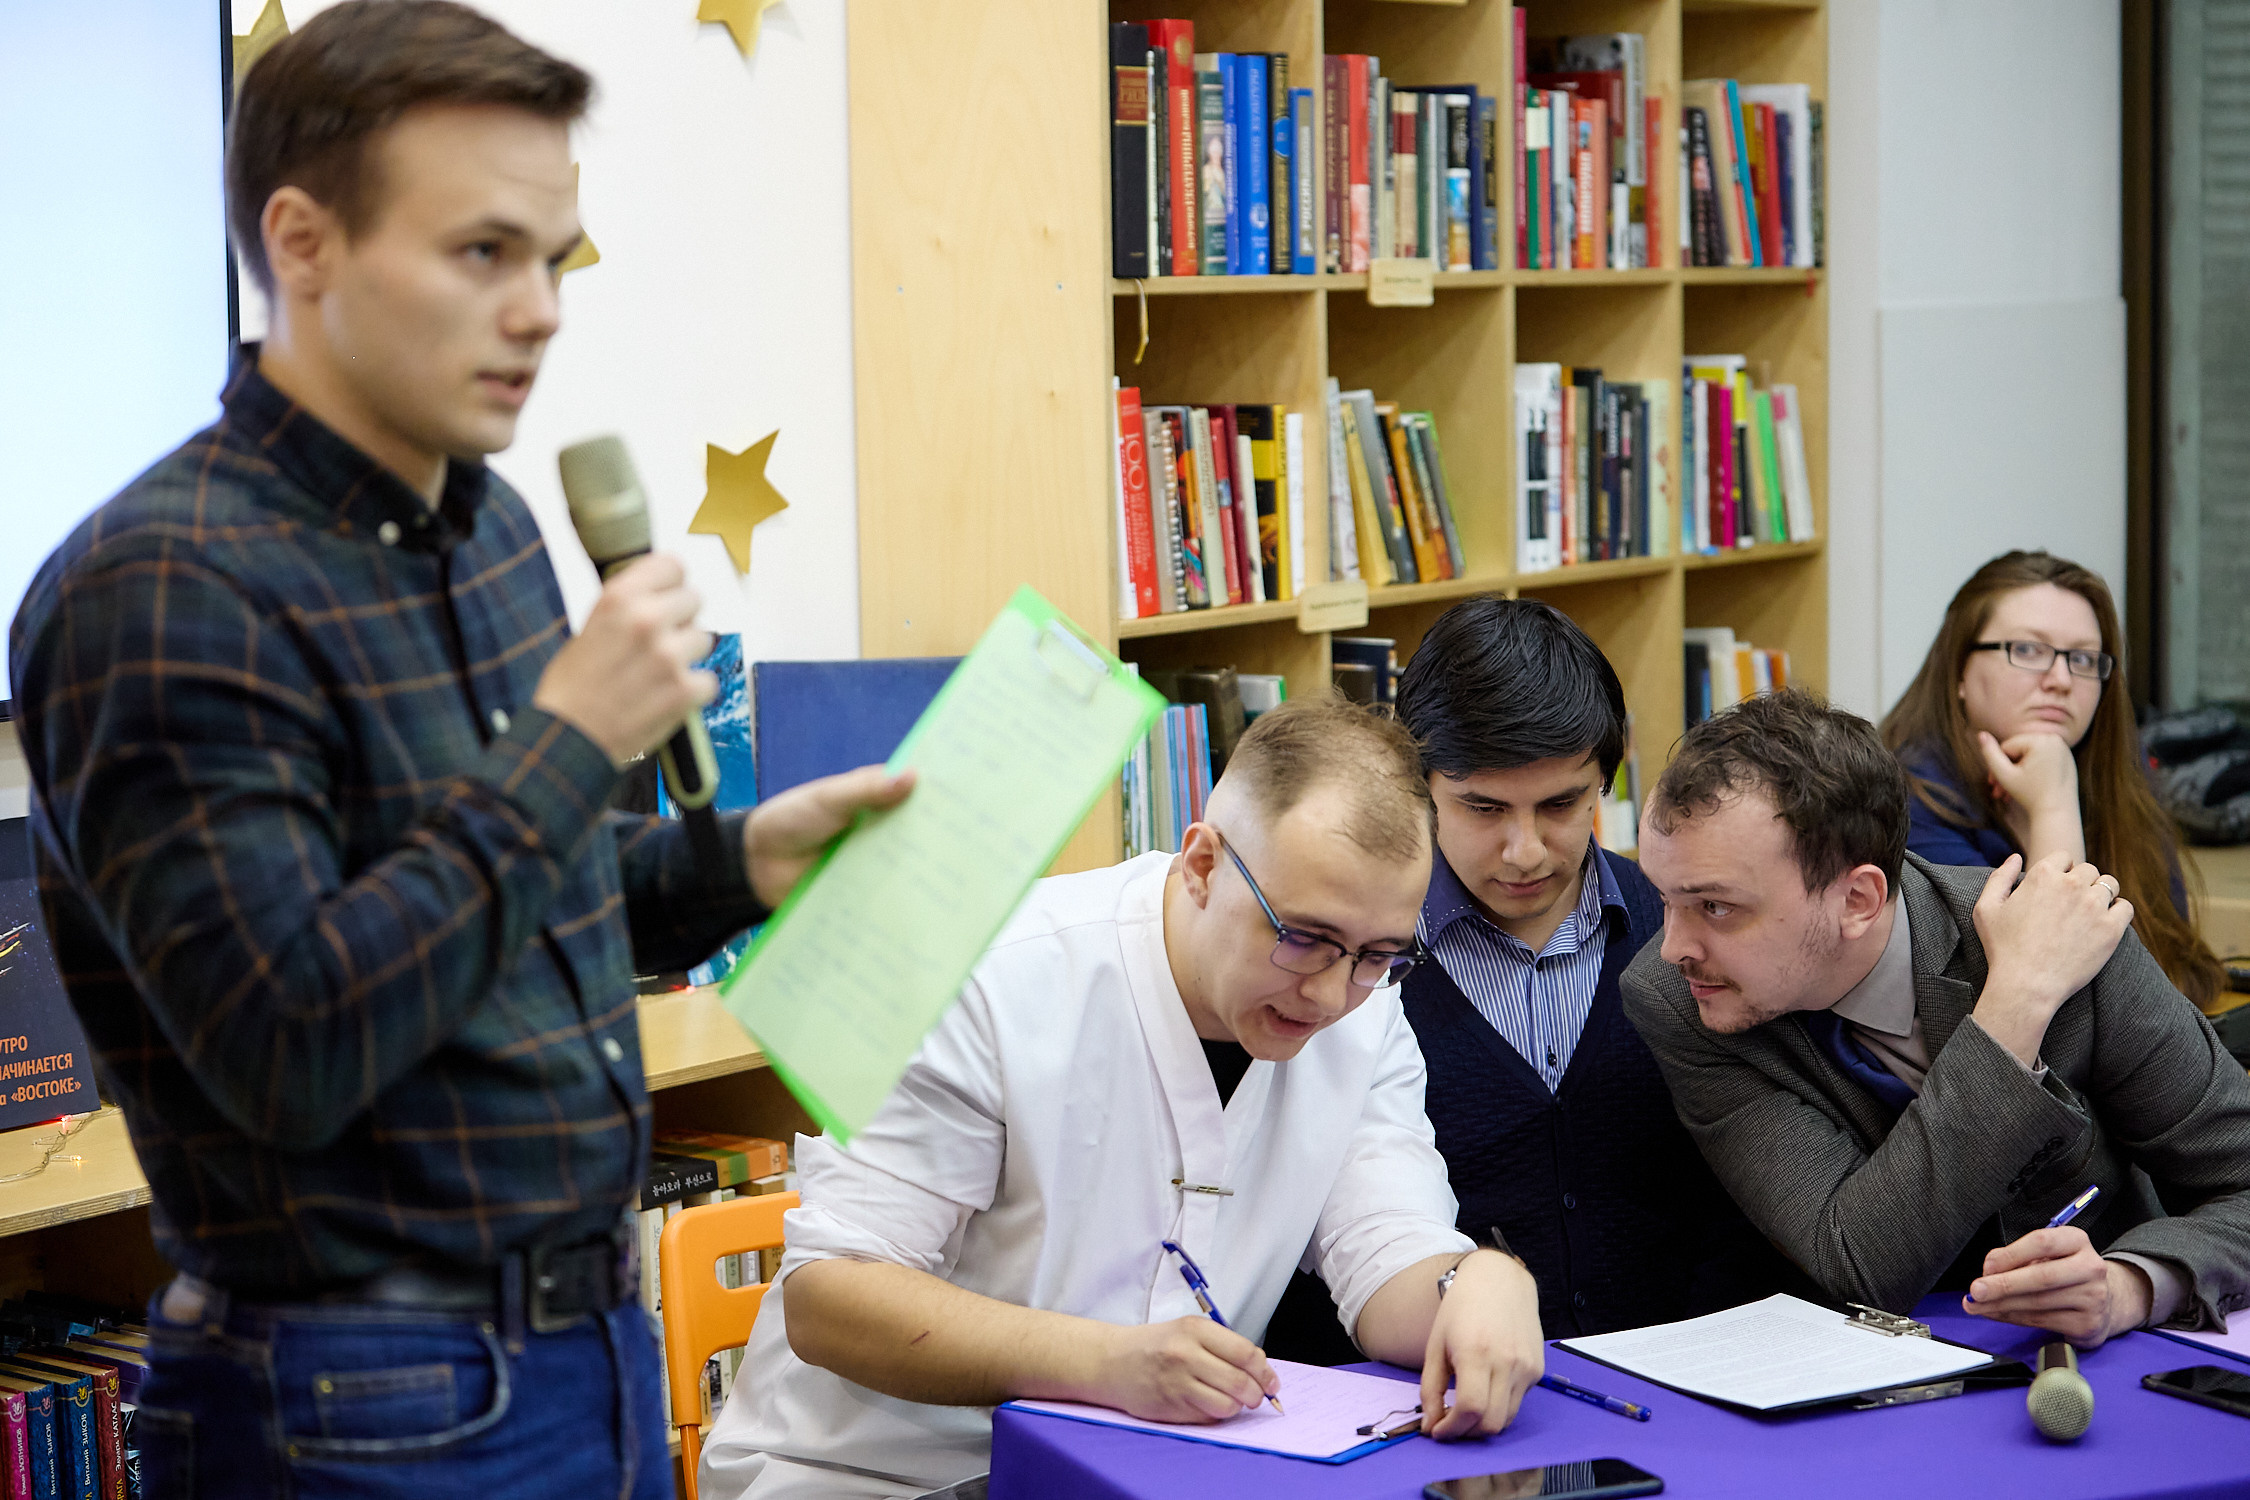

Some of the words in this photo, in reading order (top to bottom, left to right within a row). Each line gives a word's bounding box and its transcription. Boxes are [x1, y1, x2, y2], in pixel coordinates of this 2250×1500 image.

[11, 1077, 82, 1103] «ВОСТОКЕ»
[80, 1413, 89, 1447] ЗЫКОВ
[111, 1401, 120, 1438] КАТЛАС
[16, 1427, 25, 1472] ЗЛОТНИКОВ
[45, 1422, 54, 1456] ЗЫКОВ
[48, 1458, 56, 1496] Виталий
[116, 1478, 125, 1500] РАГА
